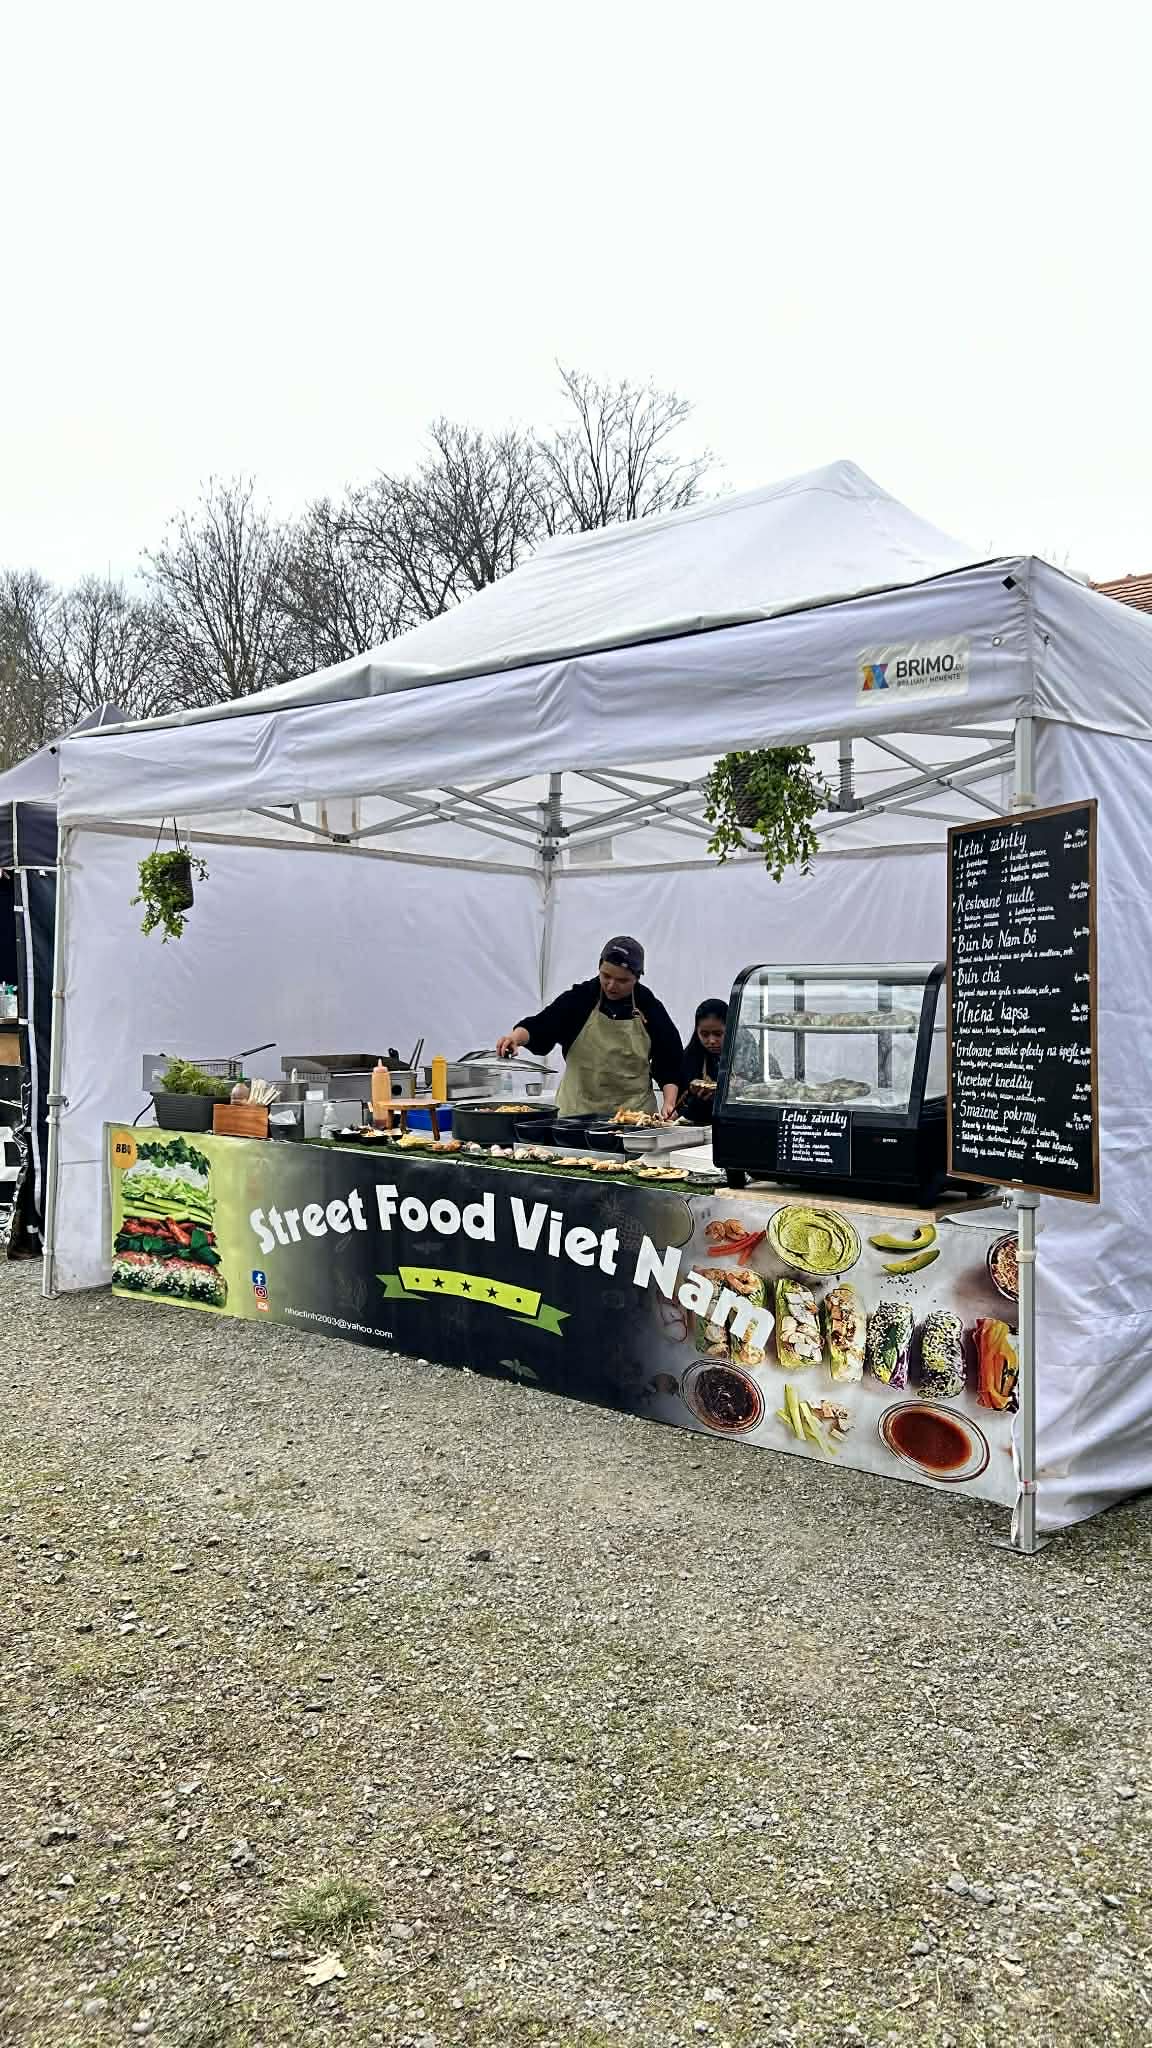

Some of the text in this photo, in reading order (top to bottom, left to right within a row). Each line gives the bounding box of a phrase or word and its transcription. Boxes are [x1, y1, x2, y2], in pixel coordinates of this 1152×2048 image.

[896, 654, 954, 678] BRIMO
[897, 672, 961, 688] BRILLIANT MOMENTS
[1006, 886, 1035, 904] nudle
[998, 928, 1021, 948] Nam
[1000, 1001, 1031, 1026] kapsa
[1046, 1046, 1057, 1056] na
[959, 1099, 1000, 1120] Smažené
[1003, 1105, 1038, 1126] pokrmy
[249, 1184, 776, 1349] Street Food Viet Nam
